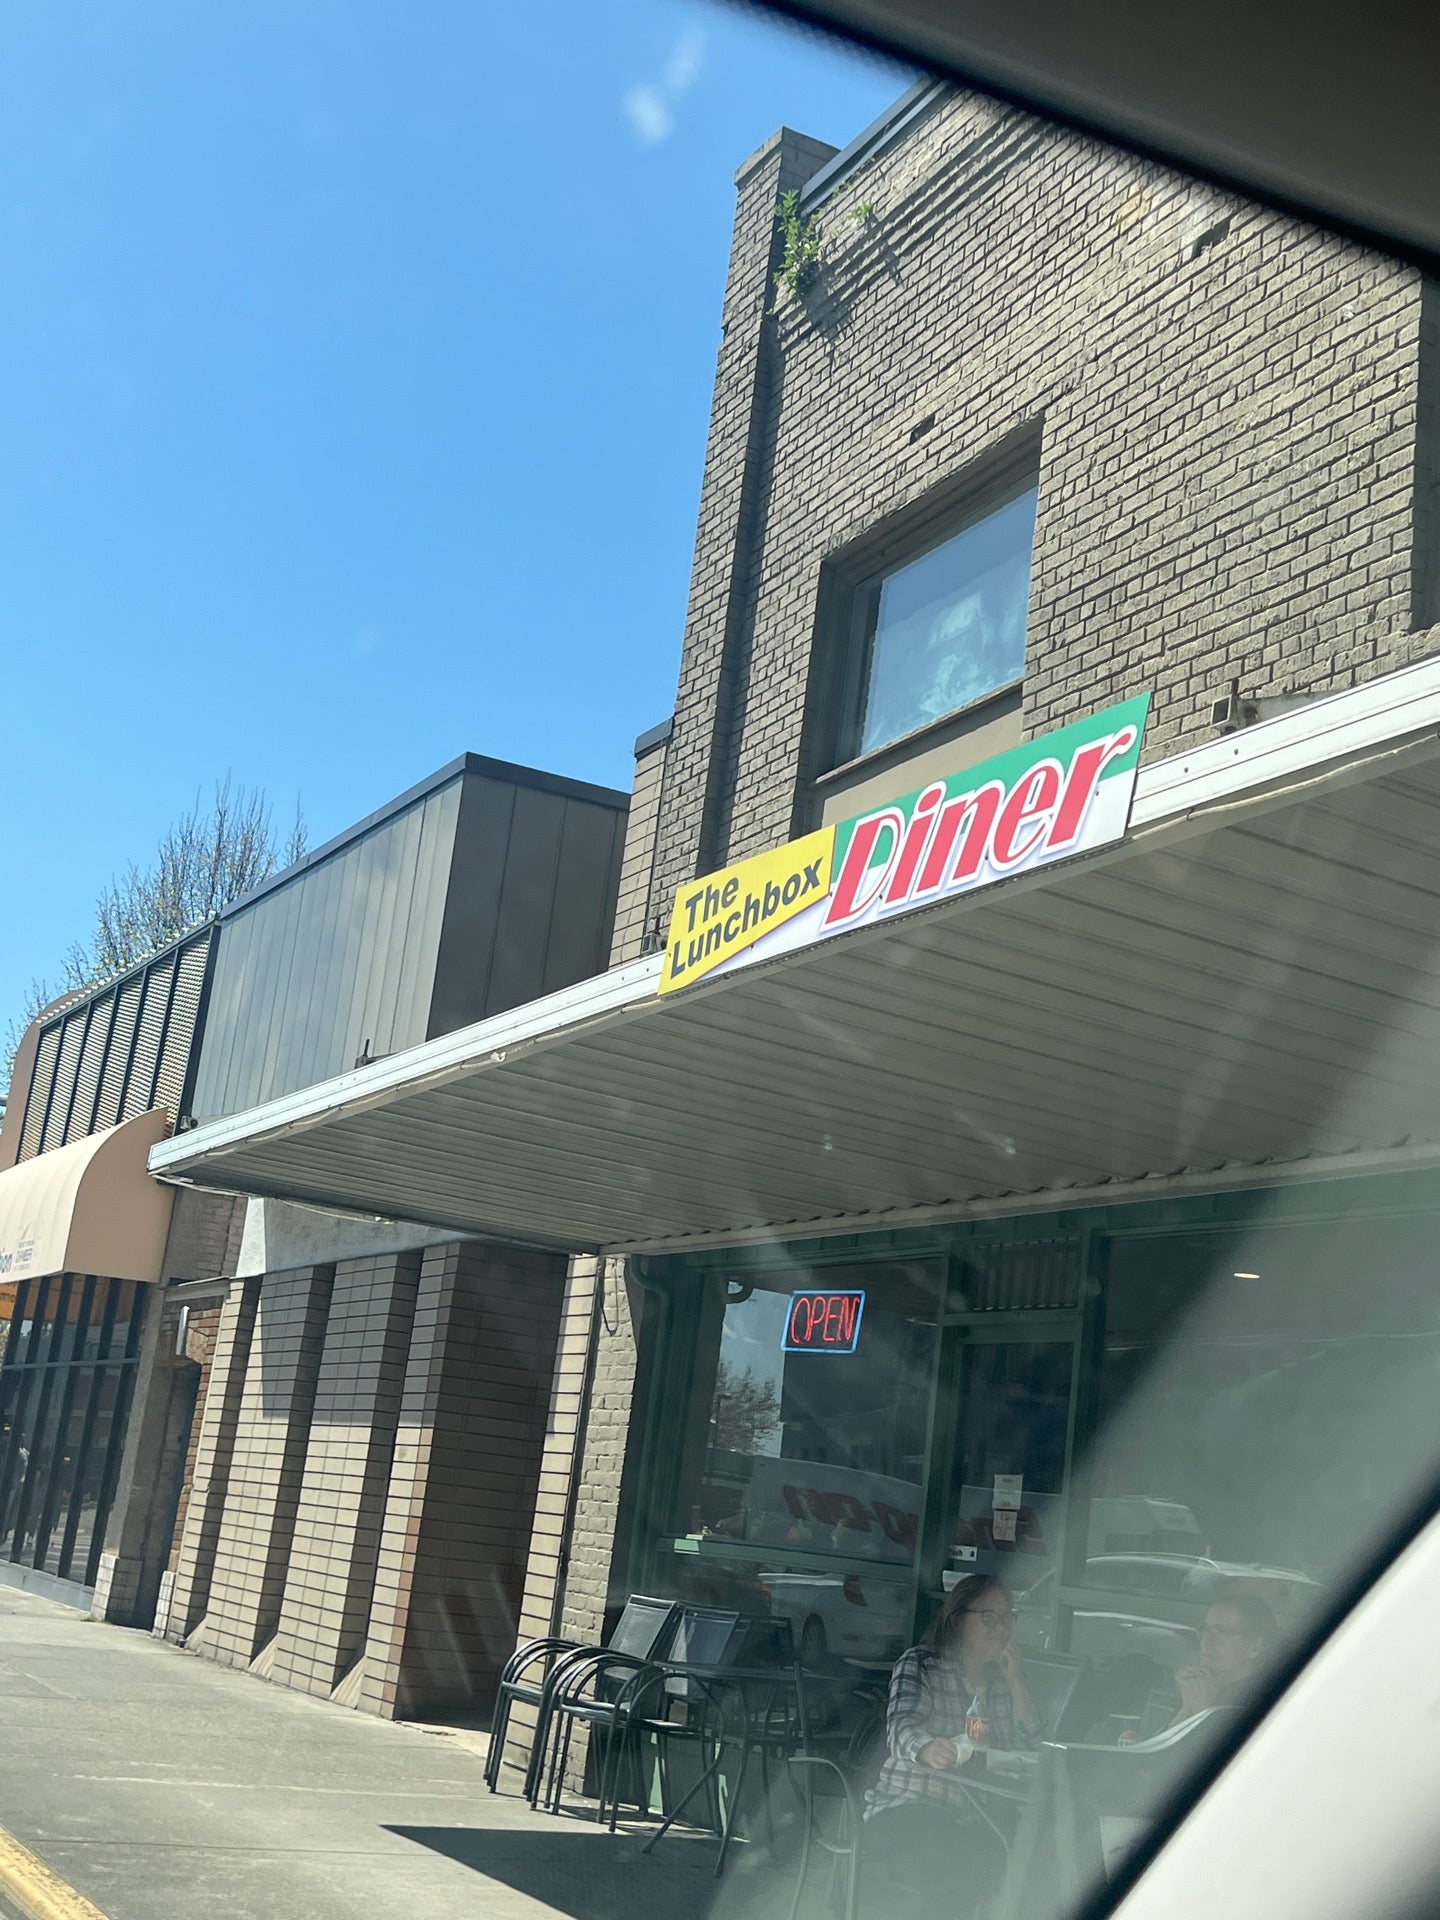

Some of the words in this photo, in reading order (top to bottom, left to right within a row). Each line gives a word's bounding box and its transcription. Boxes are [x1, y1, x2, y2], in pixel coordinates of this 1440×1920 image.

[824, 729, 1134, 924] Diner
[670, 857, 824, 980] Lunchbox
[685, 876, 739, 934] The
[791, 1296, 860, 1343] OPEN
